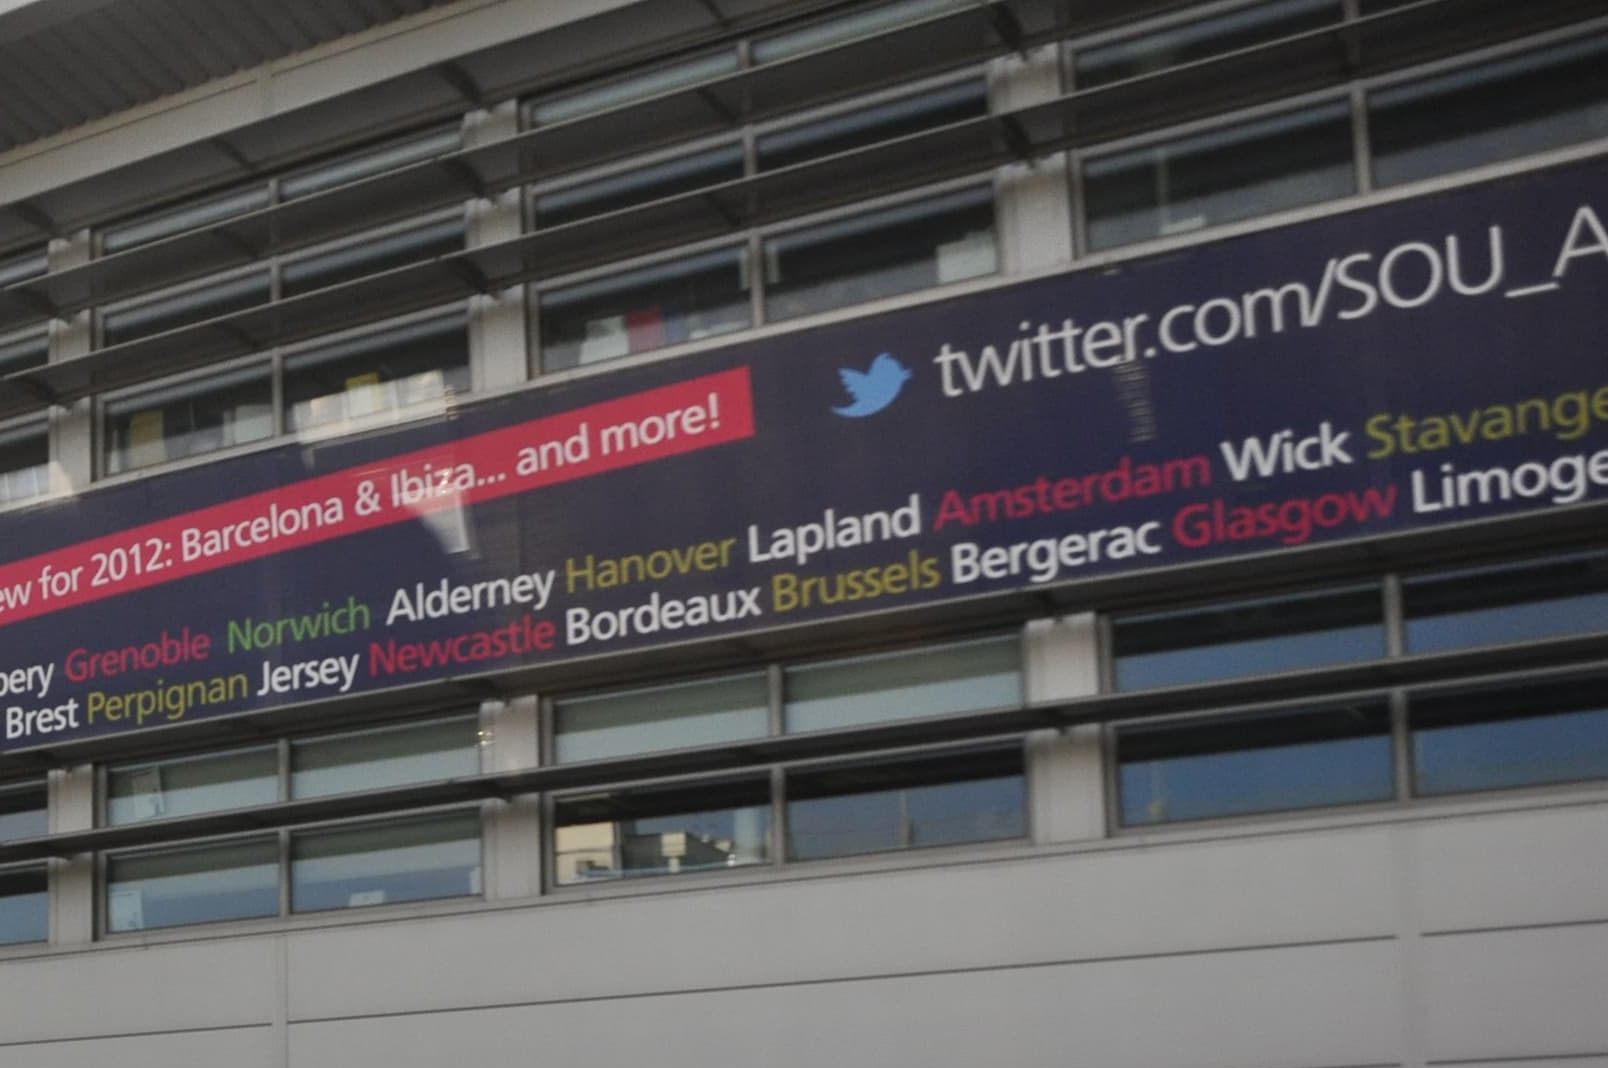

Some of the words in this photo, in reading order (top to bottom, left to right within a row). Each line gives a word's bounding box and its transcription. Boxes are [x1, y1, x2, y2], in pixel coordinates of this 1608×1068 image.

[5, 698, 79, 740] Brest
[87, 671, 249, 724] Perpignan
[256, 653, 360, 696] Jersey
[369, 613, 556, 678] Newcastle
[565, 582, 762, 646] Bordeaux
[772, 549, 941, 614] Brussels
[950, 520, 1162, 584] Bergerac
[1171, 486, 1398, 549] Glasgow
[39, 563, 84, 599] for
[91, 541, 173, 587] 2012:
[181, 501, 345, 563] Barcelona
[355, 479, 381, 516] &
[391, 462, 506, 508] Ibiza...
[516, 423, 590, 476] and
[600, 393, 721, 455] more!
[64, 627, 212, 683] Grenoble
[227, 597, 371, 654] Norwich
[386, 570, 556, 626] Alderney
[565, 537, 736, 594] Hanover
[748, 494, 922, 566] Lapland
[932, 456, 1213, 534] Amsterdam
[1220, 422, 1353, 483] Wick
